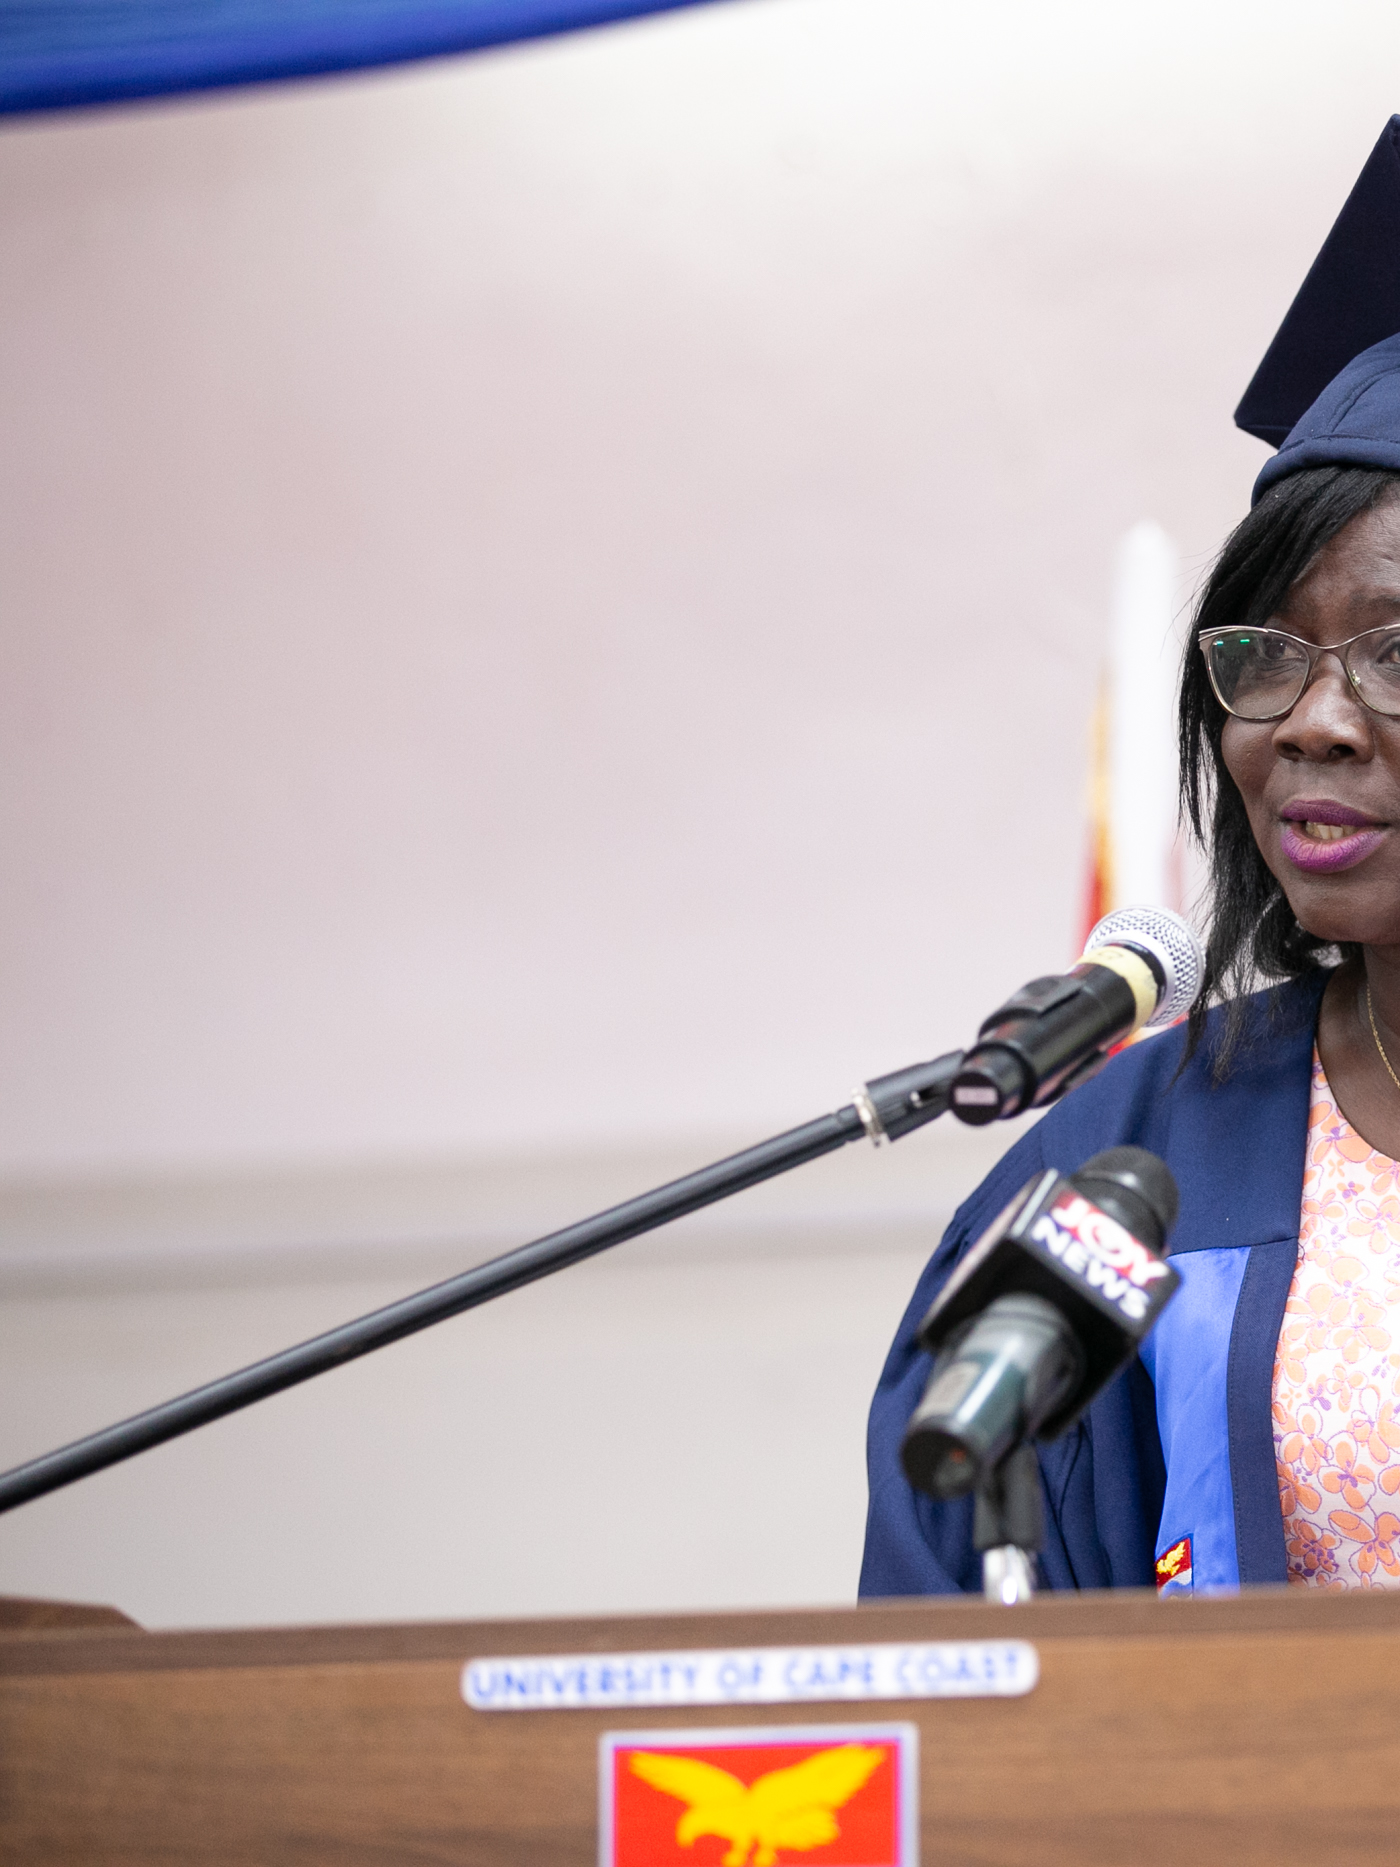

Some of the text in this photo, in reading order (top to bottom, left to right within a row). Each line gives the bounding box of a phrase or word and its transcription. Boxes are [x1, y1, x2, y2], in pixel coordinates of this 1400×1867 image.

[1031, 1215, 1150, 1319] NEWS
[472, 1645, 1021, 1704] UNIVERSITY OF CAPE COAST
